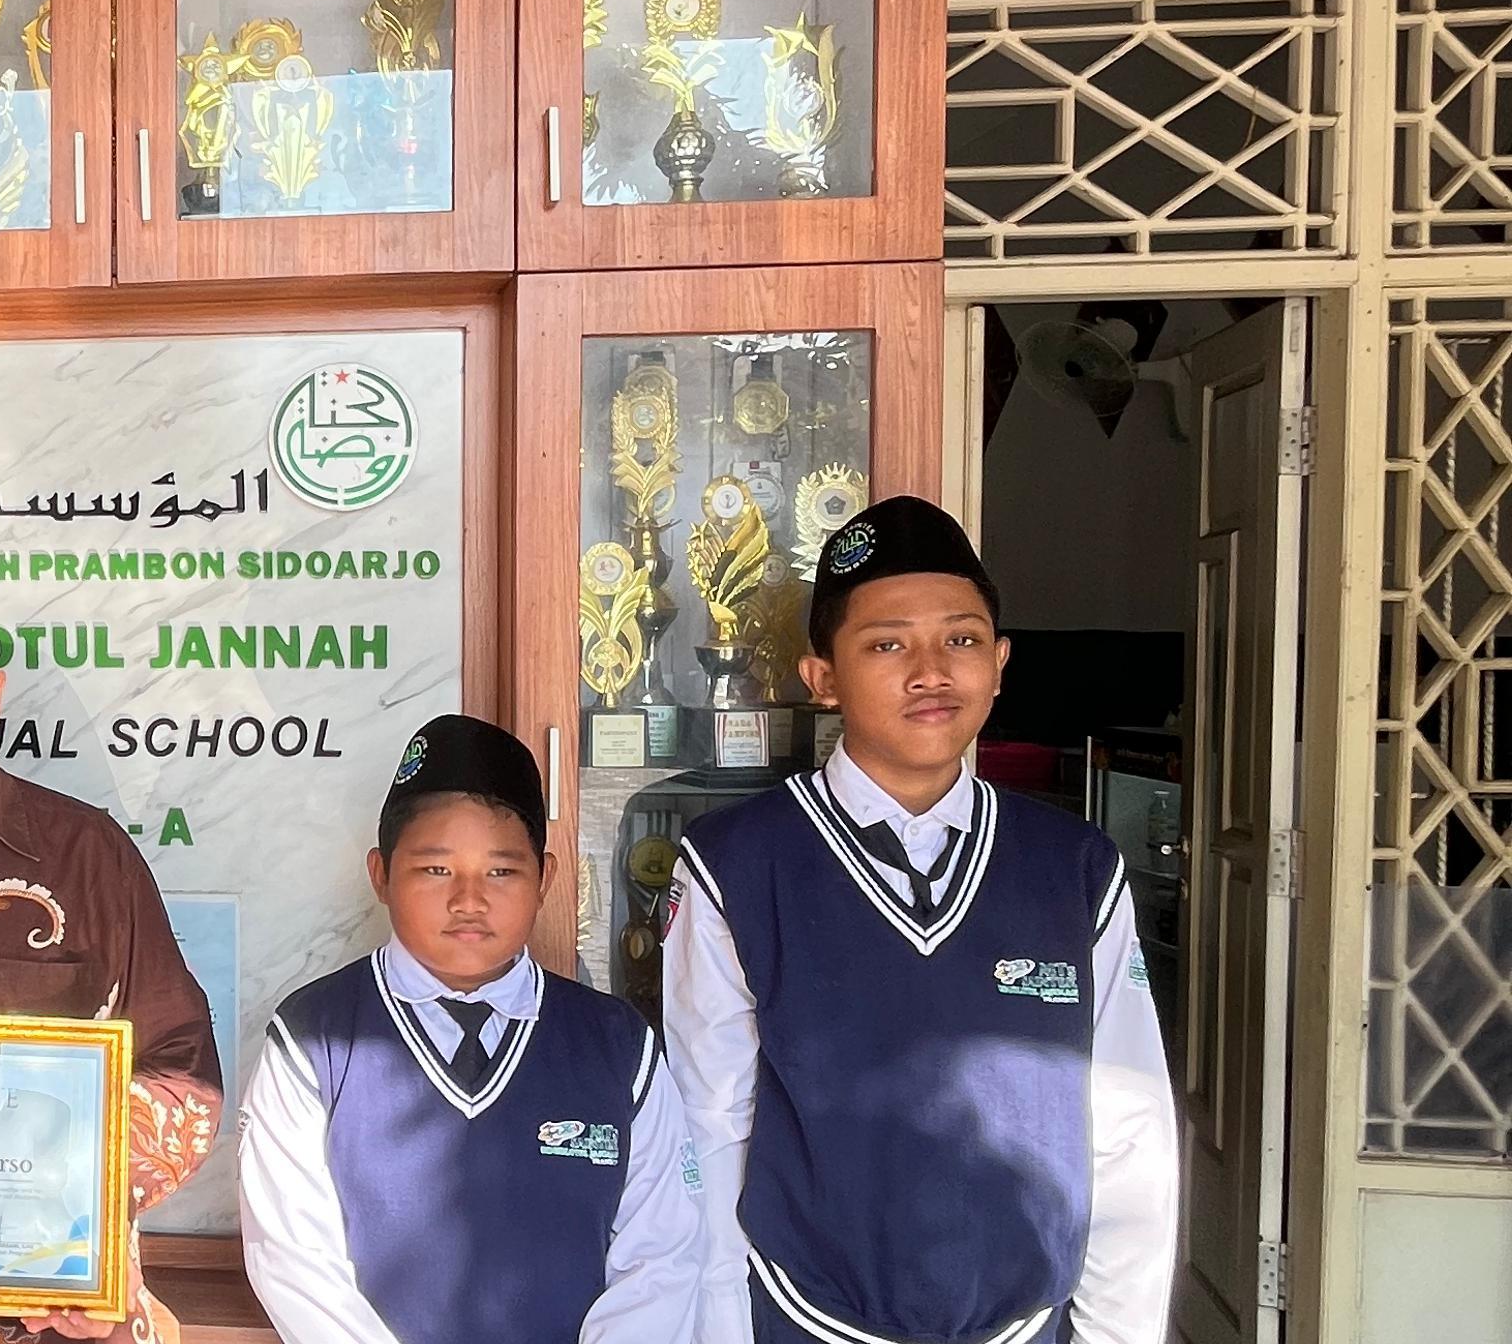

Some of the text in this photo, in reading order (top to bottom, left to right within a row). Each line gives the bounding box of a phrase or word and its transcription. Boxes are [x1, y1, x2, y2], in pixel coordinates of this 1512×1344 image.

[29, 550, 226, 581] PRAMBON
[236, 549, 441, 580] SIDOARJO
[149, 624, 389, 670] JANNAH
[108, 715, 343, 758] SCHOOL
[159, 807, 194, 846] A
